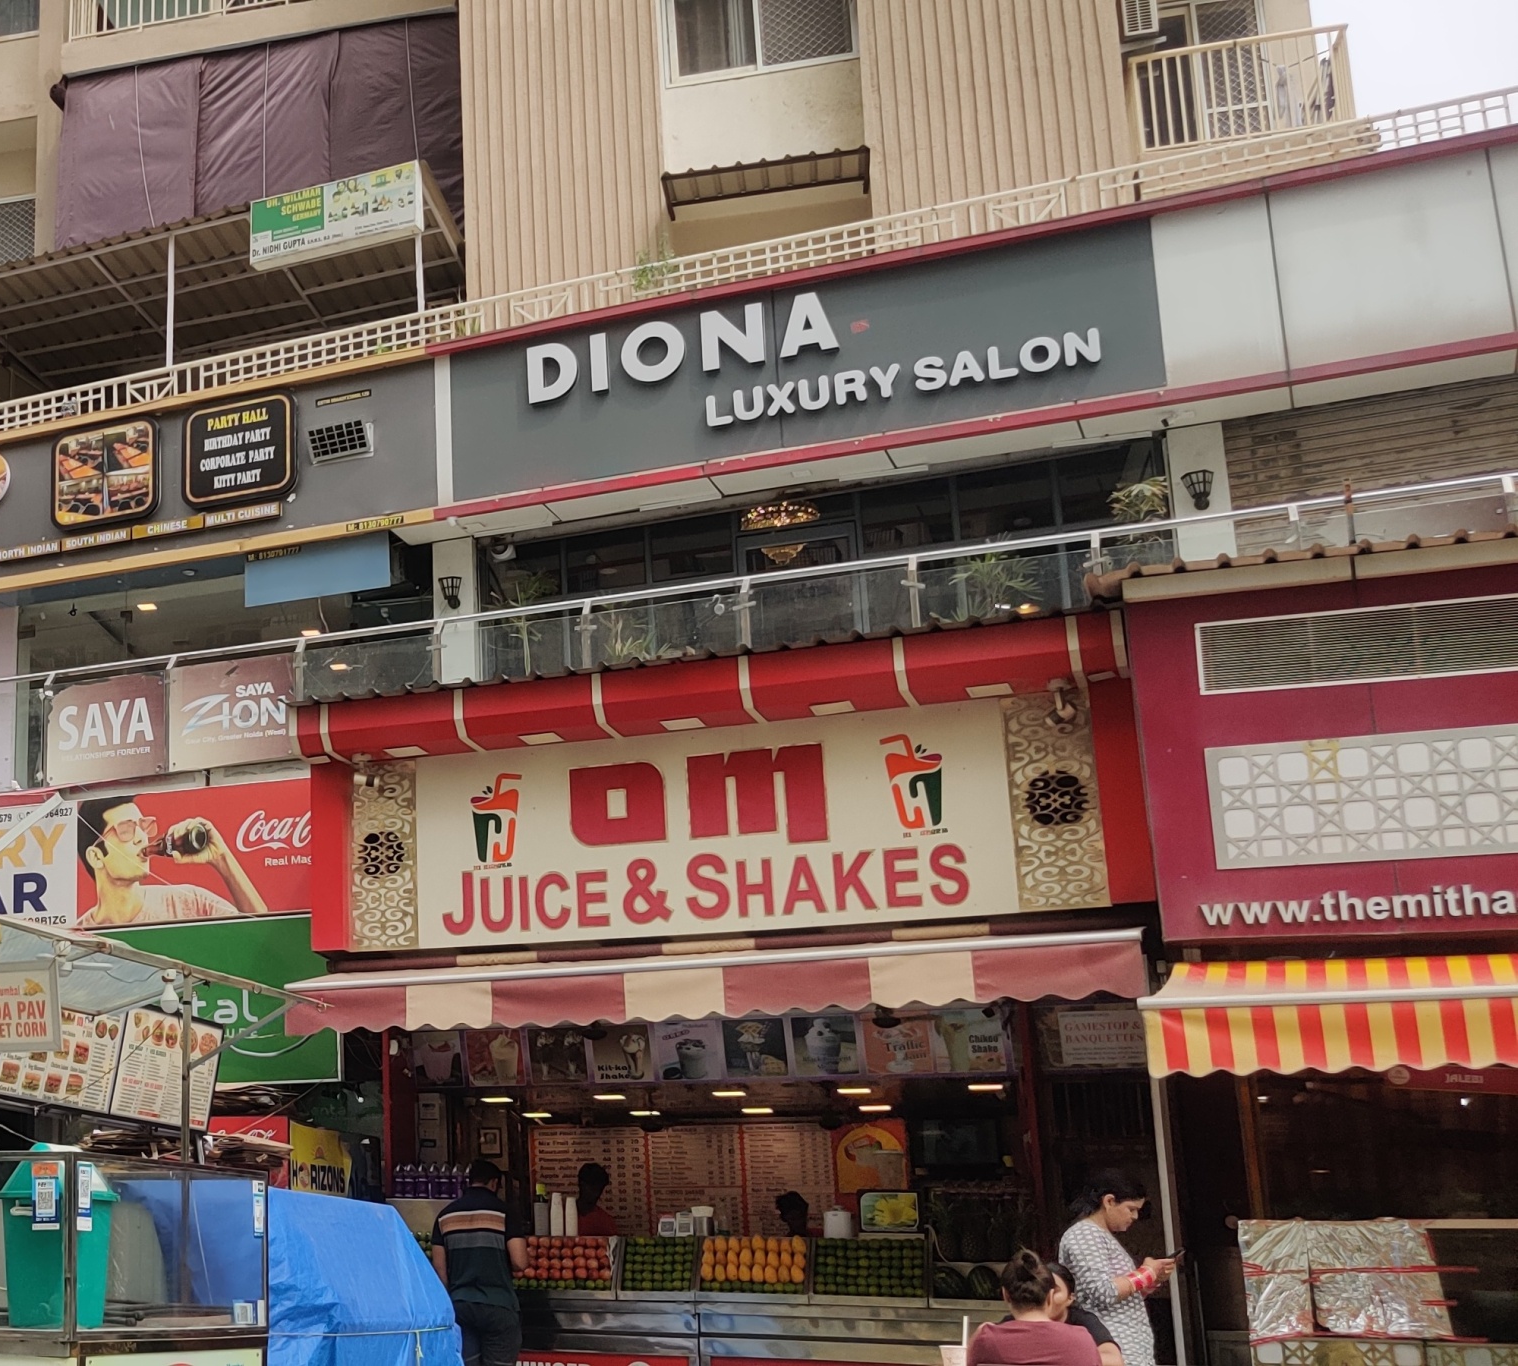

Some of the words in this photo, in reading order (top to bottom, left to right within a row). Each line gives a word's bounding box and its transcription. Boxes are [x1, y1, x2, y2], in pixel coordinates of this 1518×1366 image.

[262, 243, 281, 255] NIDHI
[283, 237, 306, 250] GUPTA
[526, 292, 840, 405] DIONA
[705, 363, 900, 427] LUXURY
[914, 327, 1101, 391] SALON
[207, 413, 240, 431] PARTY
[242, 408, 268, 424] HALL
[204, 431, 244, 451] BIRTHDAY
[245, 427, 271, 444] PARTY
[200, 451, 246, 472] CORPORATE
[248, 446, 275, 463] PARTY
[213, 473, 236, 489] KITTY
[237, 469, 261, 485] PARTY
[206, 513, 236, 526] MULTI
[237, 505, 277, 520] CUISINE
[147, 520, 187, 534] CHINESE
[65, 536, 95, 549] SOUTH
[96, 530, 127, 543] INDIAN
[27, 542, 58, 556] INDIAN
[235, 682, 274, 697] SAYA
[58, 697, 154, 750] SAYA
[180, 694, 286, 737] ZION
[244, 731, 263, 739] Noida
[117, 746, 151, 757] FOREVER
[265, 857, 289, 867] Real
[442, 867, 610, 936] JUICE
[622, 858, 675, 923] &
[685, 842, 970, 921] SHAKES
[1199, 884, 1517, 926] www.themitha
[16, 999, 46, 1020] PAV
[13, 1020, 47, 1038] CORN
[1064, 1021, 1129, 1031] GAMESTOP
[883, 1039, 926, 1053] Traffic
[968, 1034, 999, 1044] Chikoo
[1065, 1033, 1144, 1044] BANQUETTES
[972, 1044, 999, 1053] Shake
[1444, 1072, 1484, 1084] JALEBI
